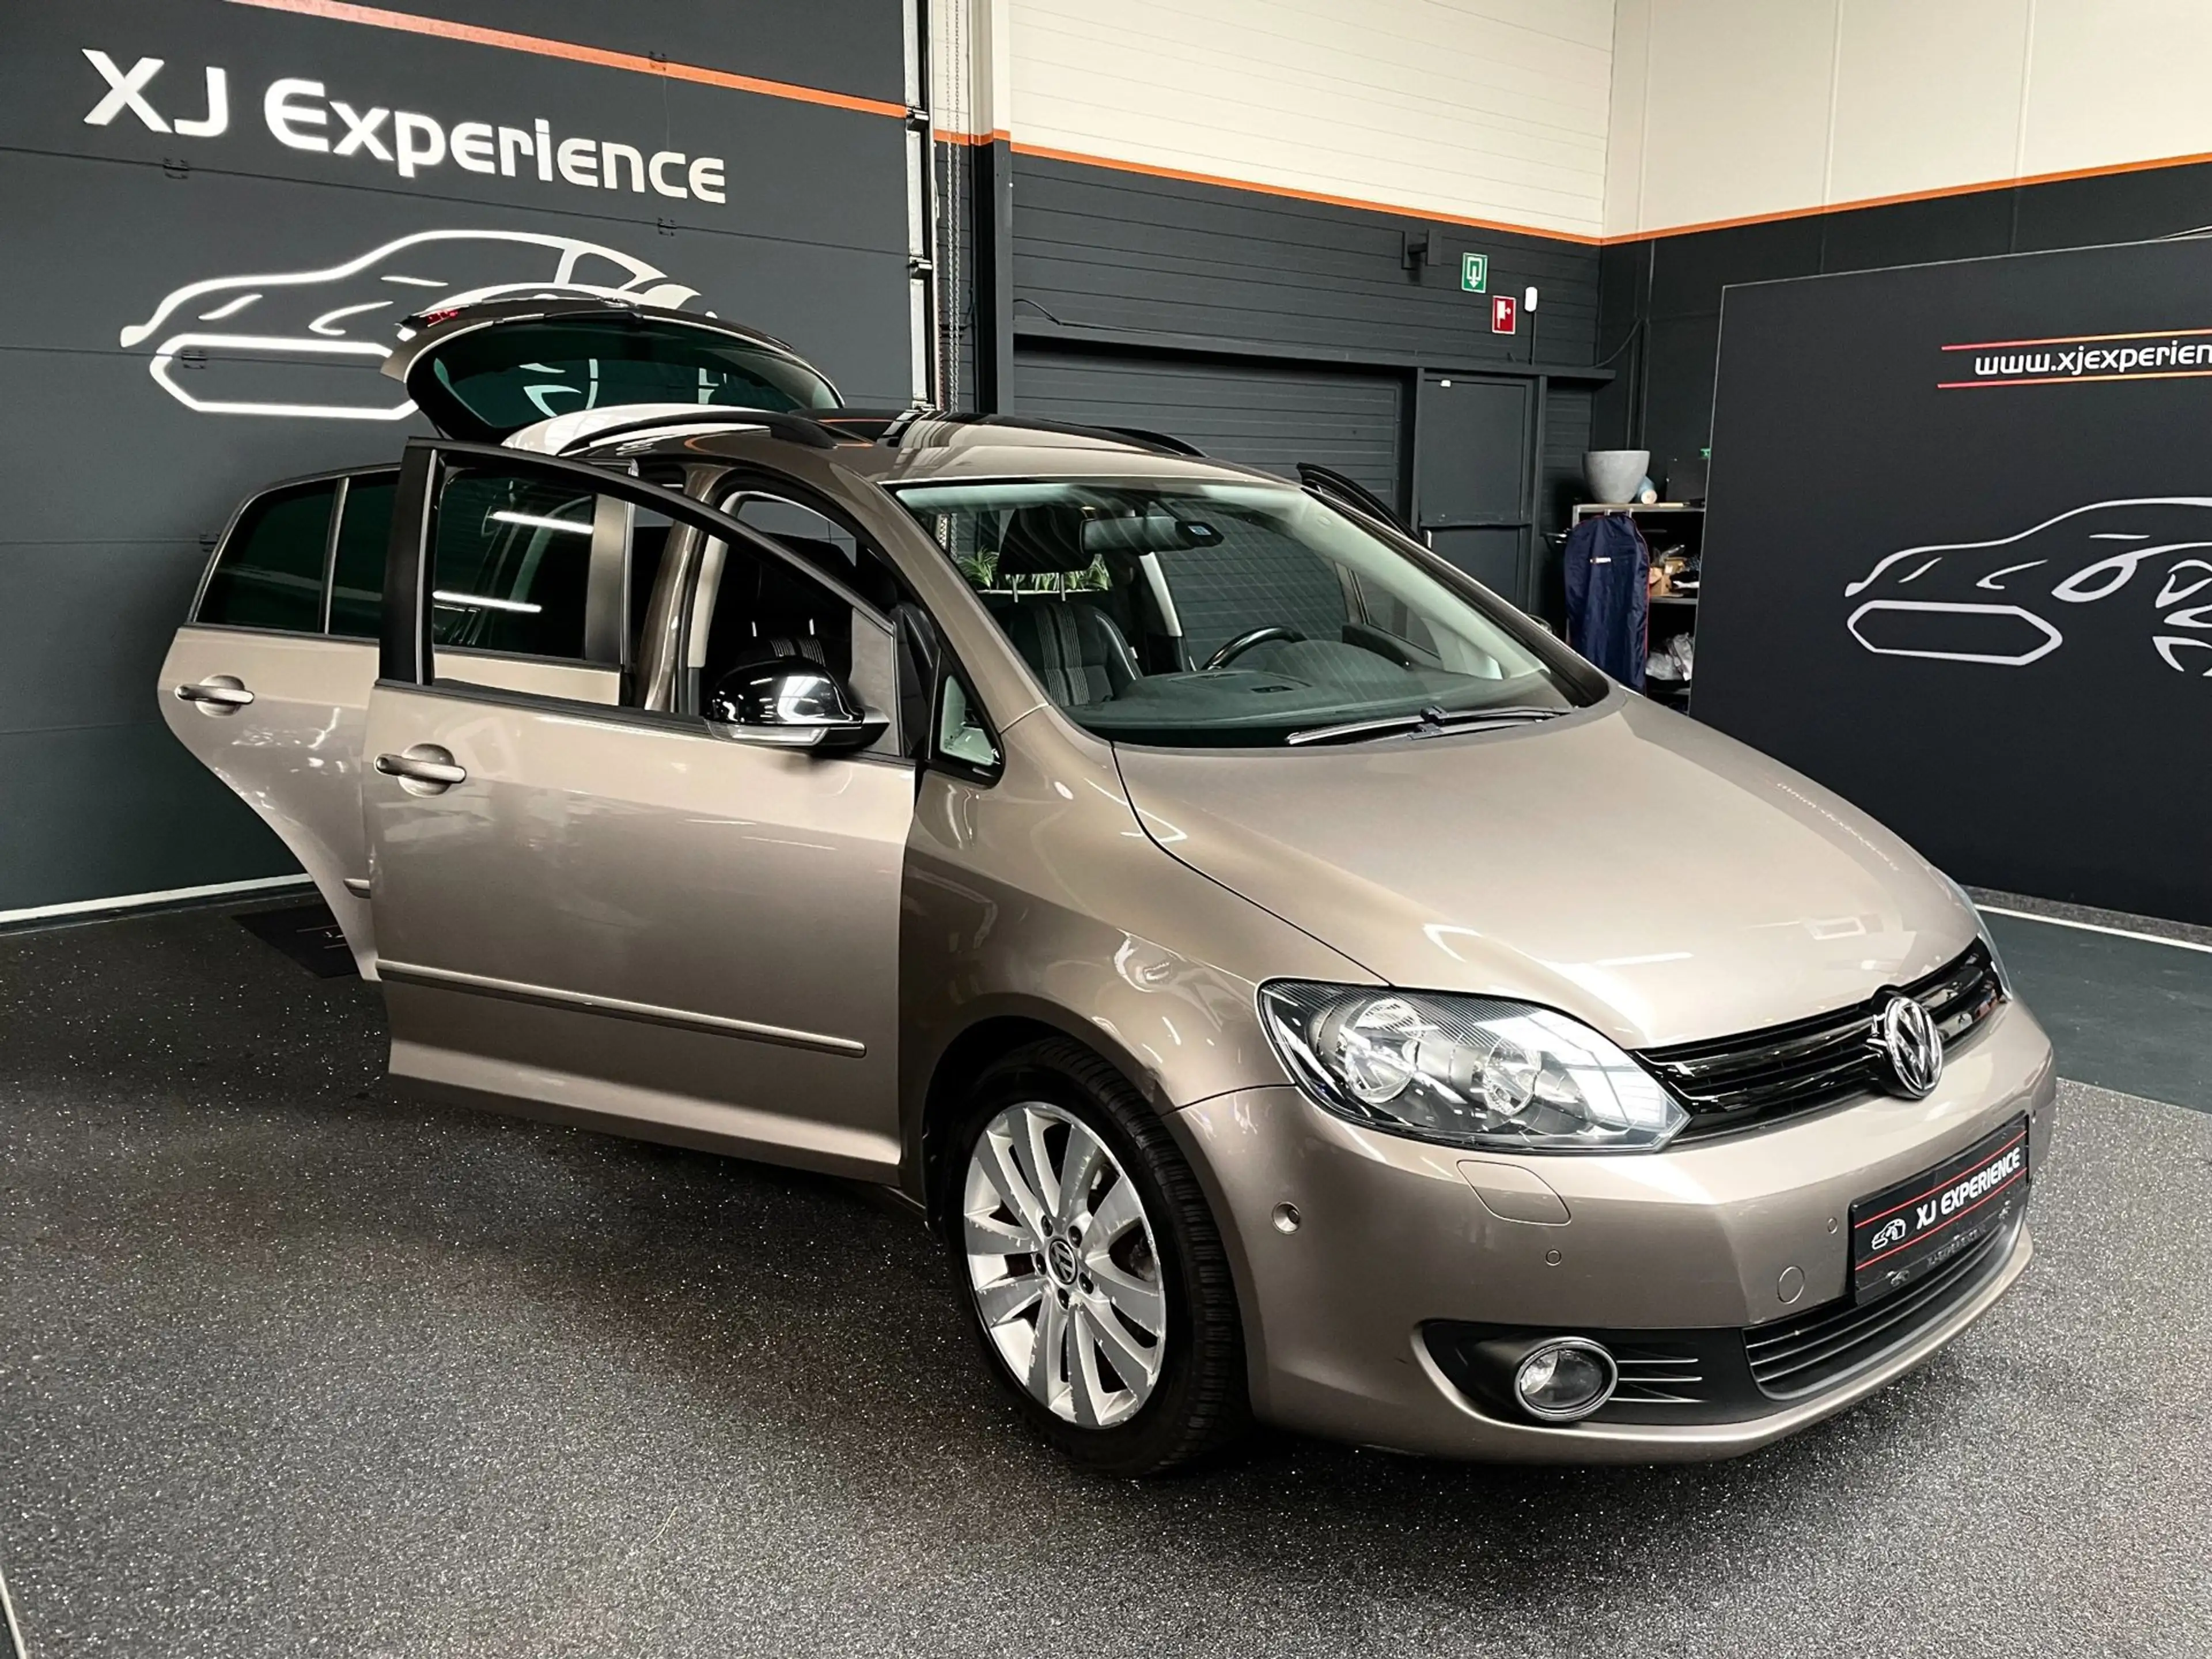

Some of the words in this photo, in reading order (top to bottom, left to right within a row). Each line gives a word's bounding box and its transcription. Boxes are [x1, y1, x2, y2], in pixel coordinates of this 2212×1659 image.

[82, 49, 228, 137] XJ
[264, 78, 726, 204] Experience
[1975, 340, 2212, 376] www.xjexperien
[1916, 1199, 1937, 1230] XJ
[1941, 1146, 2020, 1215] EXPERIENCE
